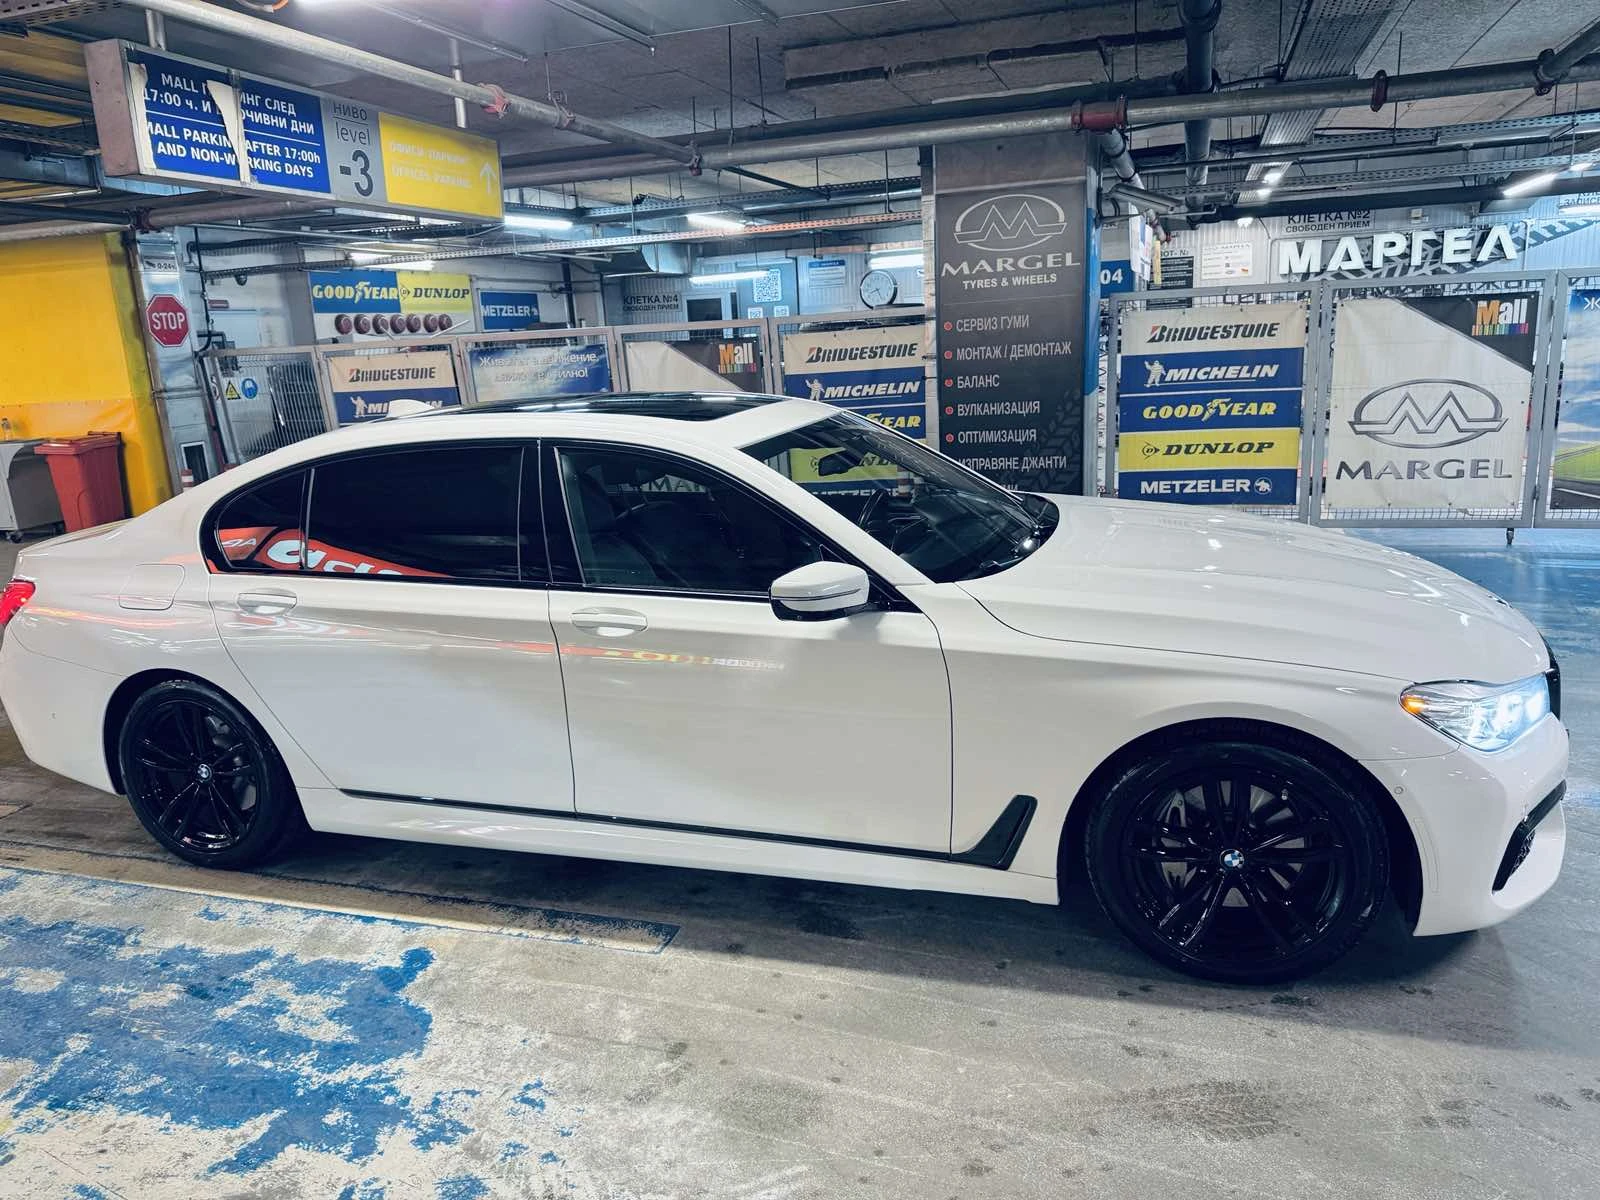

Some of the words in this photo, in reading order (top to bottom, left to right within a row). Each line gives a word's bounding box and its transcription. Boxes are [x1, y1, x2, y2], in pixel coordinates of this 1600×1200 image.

[161, 73, 198, 93] MALL
[265, 97, 297, 117] СЛЕД
[291, 120, 315, 136] ДНИ
[336, 122, 371, 146] level
[183, 128, 233, 149] PARKIN
[284, 147, 321, 164] 17:00h
[157, 141, 187, 158] AND
[191, 148, 282, 174] NON-WRKING
[285, 162, 314, 179] DAYS
[339, 149, 374, 198] -3
[1285, 222, 1336, 233] СВОБОДЕН
[1338, 220, 1370, 229] ПРИЕМ
[1278, 224, 1518, 275] МАРГЕЛ
[941, 252, 1080, 277] MARGEL
[963, 278, 998, 290] TYRES
[1001, 276, 1008, 287] &
[1012, 273, 1057, 286] WHEELS
[413, 287, 470, 299] DUNLOP
[480, 304, 531, 317] METZELER
[1476, 298, 1528, 325] Mall
[152, 312, 185, 330] STOP
[956, 316, 998, 332] СЕРВИЗ
[1001, 315, 1030, 329] ГУМИ
[1147, 322, 1280, 344] BRIDGESTONE
[719, 343, 753, 365] Mall
[806, 343, 918, 364] BRIDGESTONE
[956, 346, 1002, 361] МОНТАЖ
[1010, 341, 1072, 361] ДЕМОНТАЖ
[348, 367, 437, 383] BRIDGESTONE
[1165, 364, 1280, 381] MICHELIN
[824, 381, 920, 398] MICHELIN
[957, 374, 1000, 389] БАЛАНС
[957, 401, 1041, 417] ВУЛКАНИЗАЦИЯ
[958, 429, 1037, 444] ОПТИМИЗАЦИЯ
[1163, 442, 1274, 456] DUNLOP
[1021, 455, 1067, 472] ДЖАНТИ
[1336, 458, 1513, 480] MARGEL
[1140, 478, 1251, 495] METZELER
